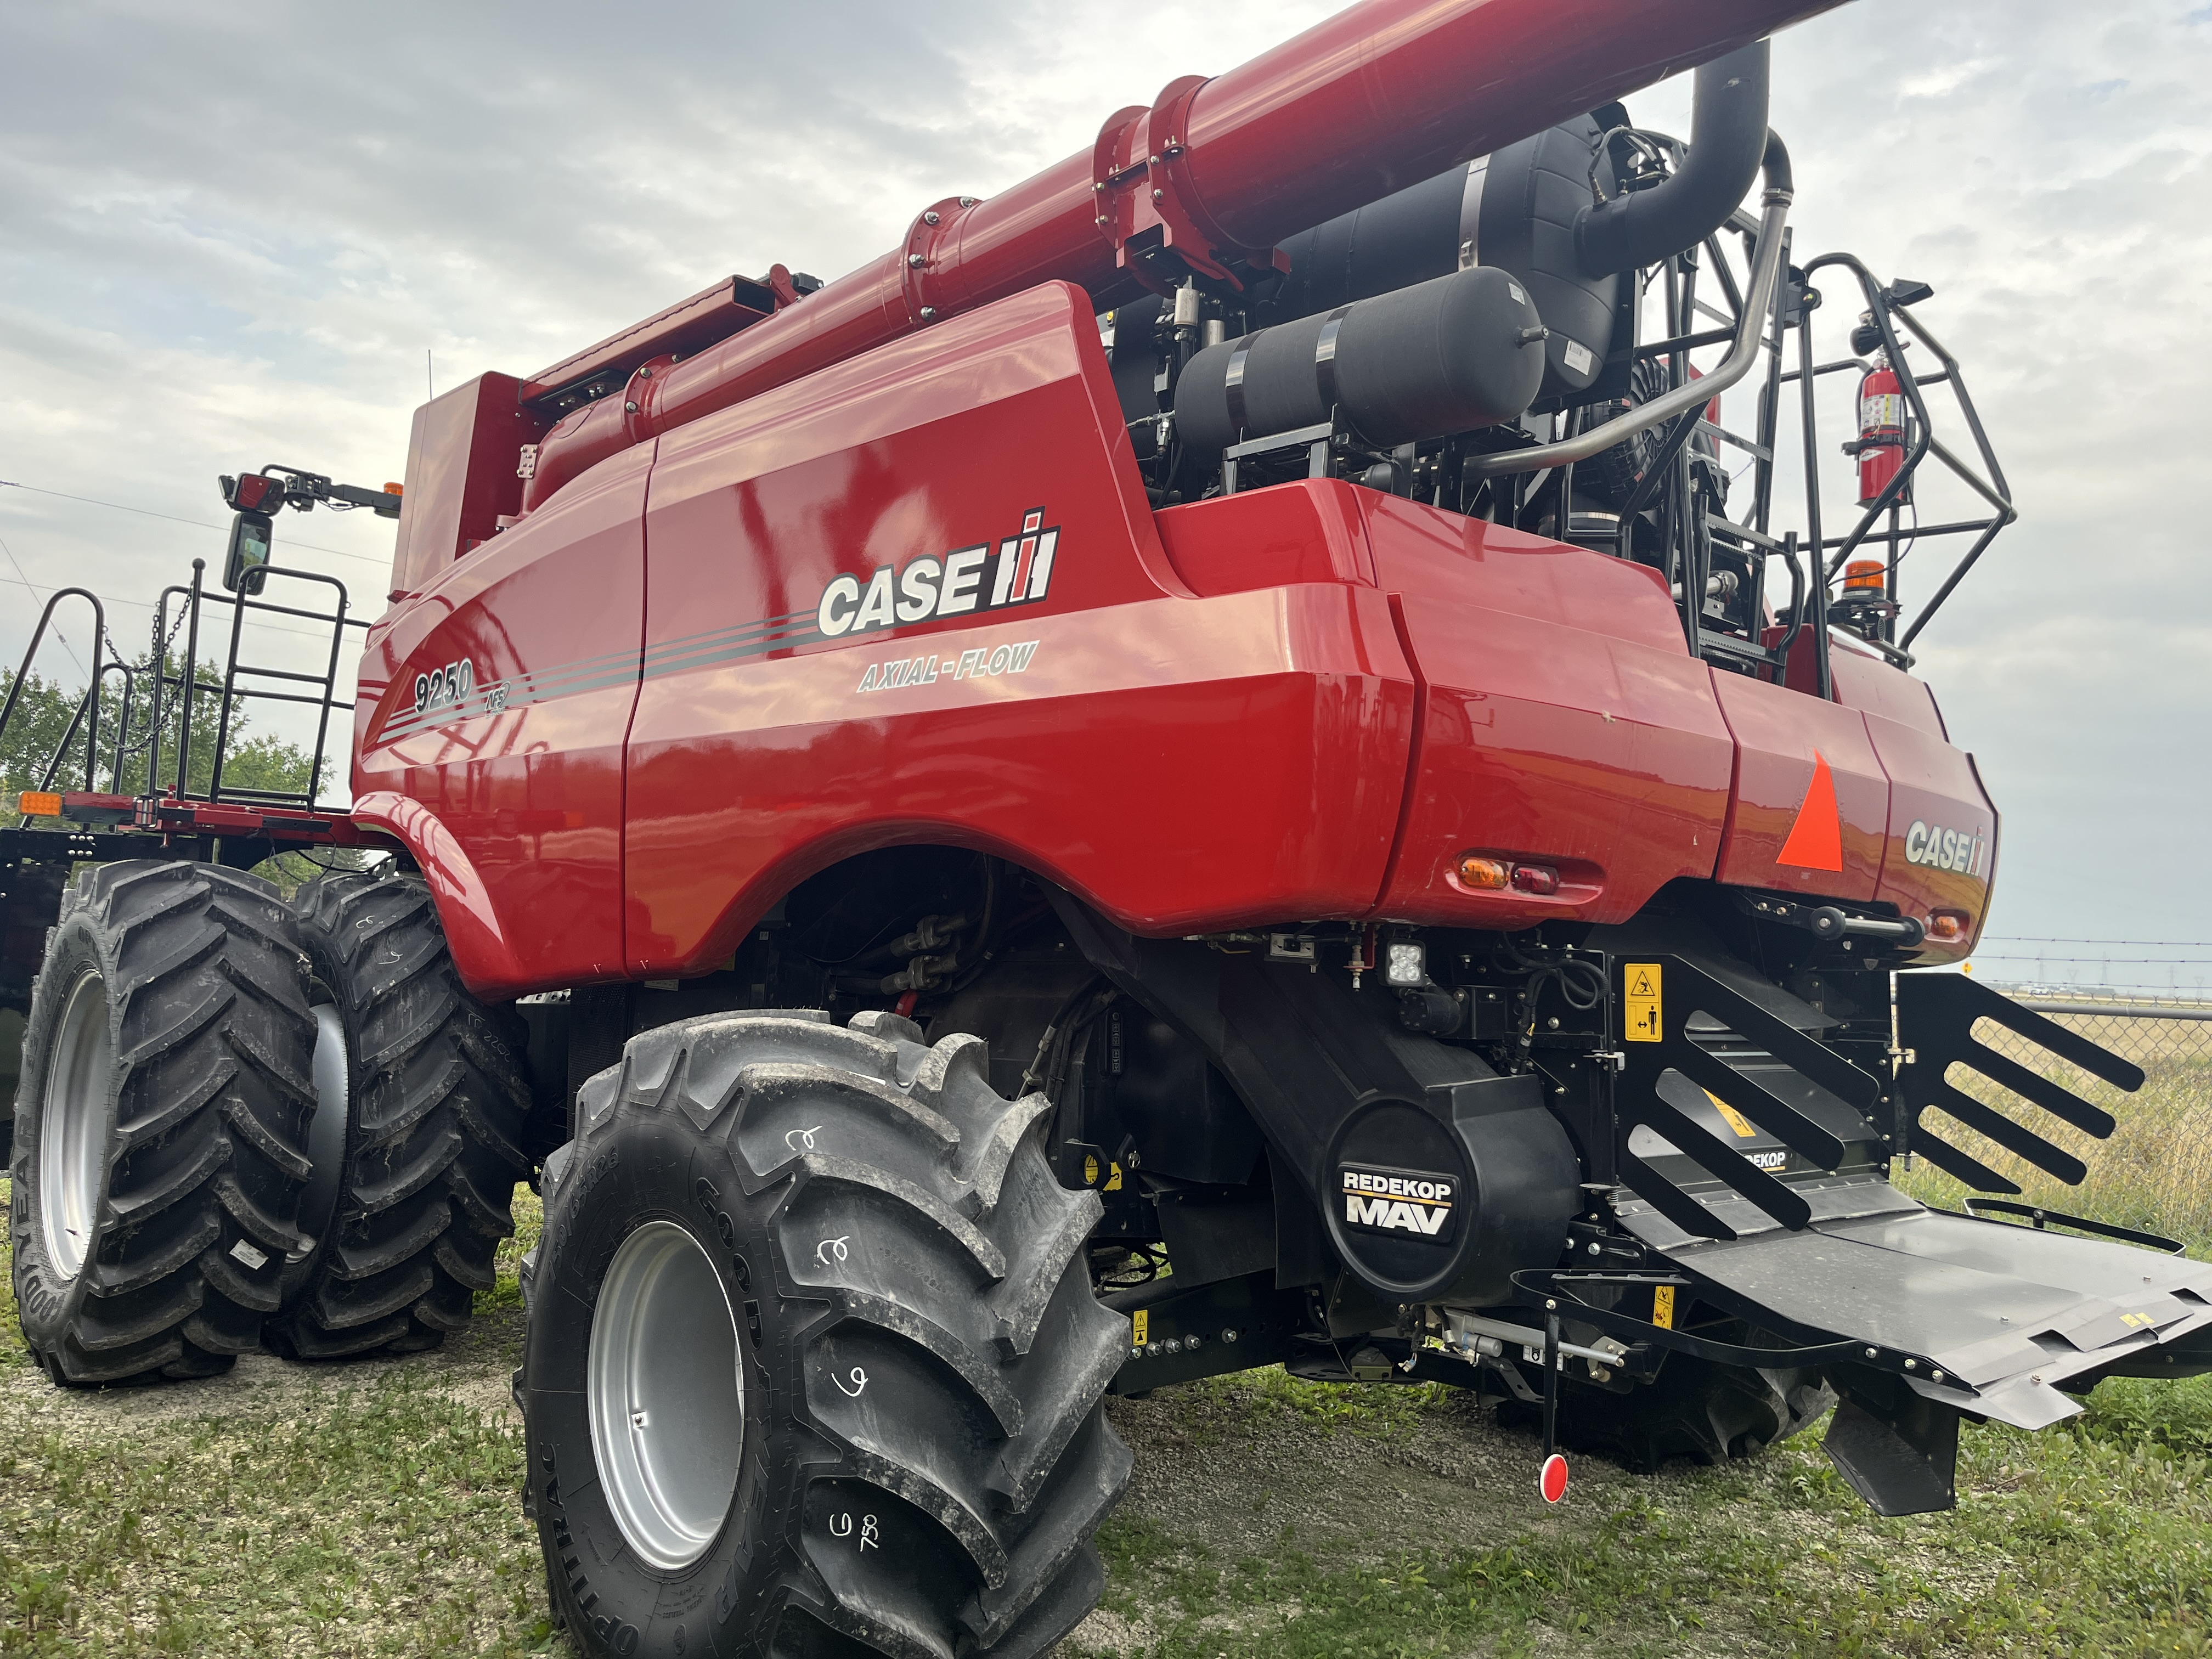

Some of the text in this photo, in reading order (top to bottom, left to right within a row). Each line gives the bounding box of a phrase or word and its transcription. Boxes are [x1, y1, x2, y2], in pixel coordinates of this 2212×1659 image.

[819, 546, 988, 636] CASE
[415, 657, 473, 715] 9250
[856, 640, 1040, 693] AXIAL-FLOW
[484, 686, 509, 712] AFS
[1905, 821, 1970, 872] CASE
[548, 1143, 619, 1282] 750/65R26
[1344, 1172, 1451, 1200] REDEKOP
[15, 1113, 67, 1324] GOODYEAR
[1346, 1195, 1449, 1235] MAV
[540, 1442, 640, 1656] OPTITRAC
[860, 1514, 879, 1552] 750
